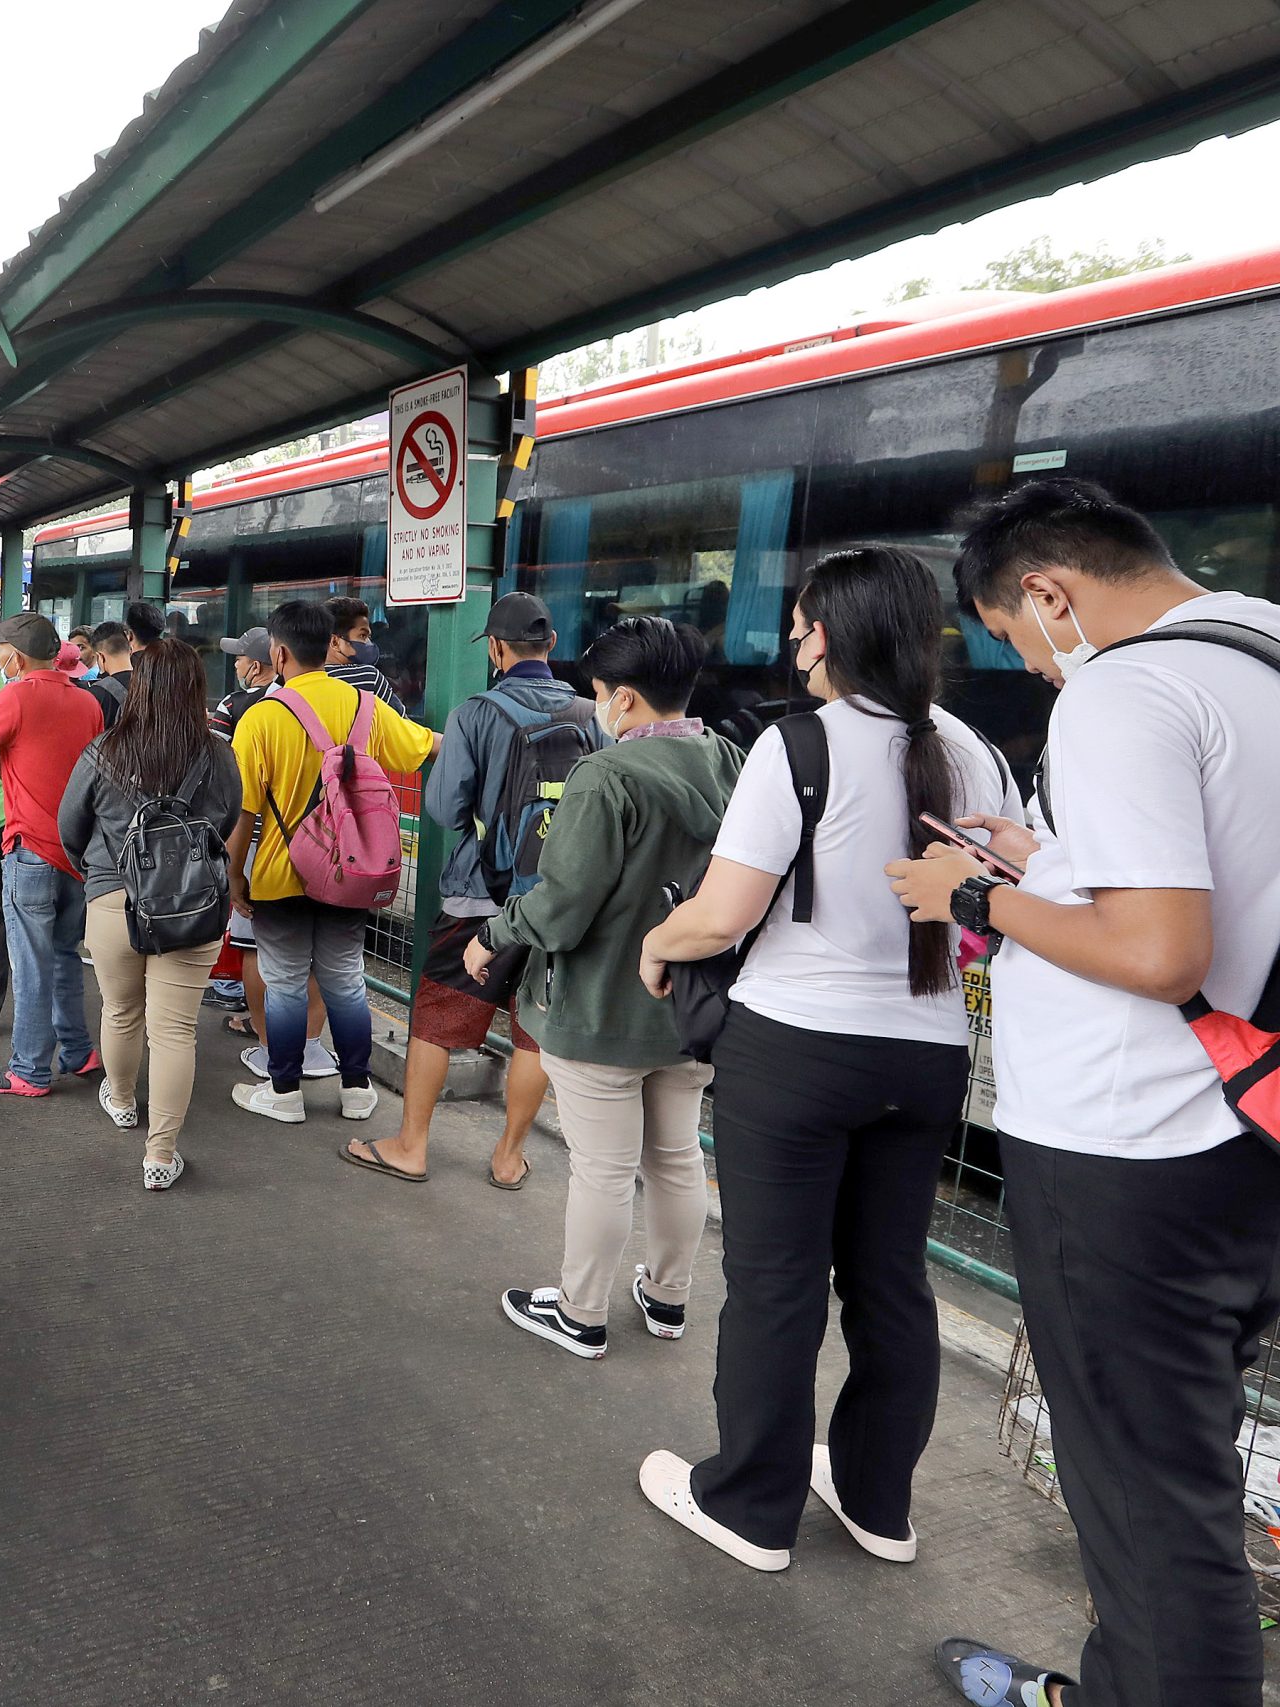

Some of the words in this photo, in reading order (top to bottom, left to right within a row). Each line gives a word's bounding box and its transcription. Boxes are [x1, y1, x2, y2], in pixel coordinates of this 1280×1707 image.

[394, 403, 404, 415] THIS
[405, 402, 409, 412] IS
[410, 401, 413, 410] A
[414, 392, 441, 409] SMOKE-FREE
[441, 385, 461, 399] FACILITY
[393, 530, 418, 545] STRICTLY
[420, 528, 429, 540] NO
[432, 523, 460, 539] SMOKING
[401, 548, 414, 560] AND
[416, 546, 426, 559] NO
[428, 543, 450, 557] VAPING
